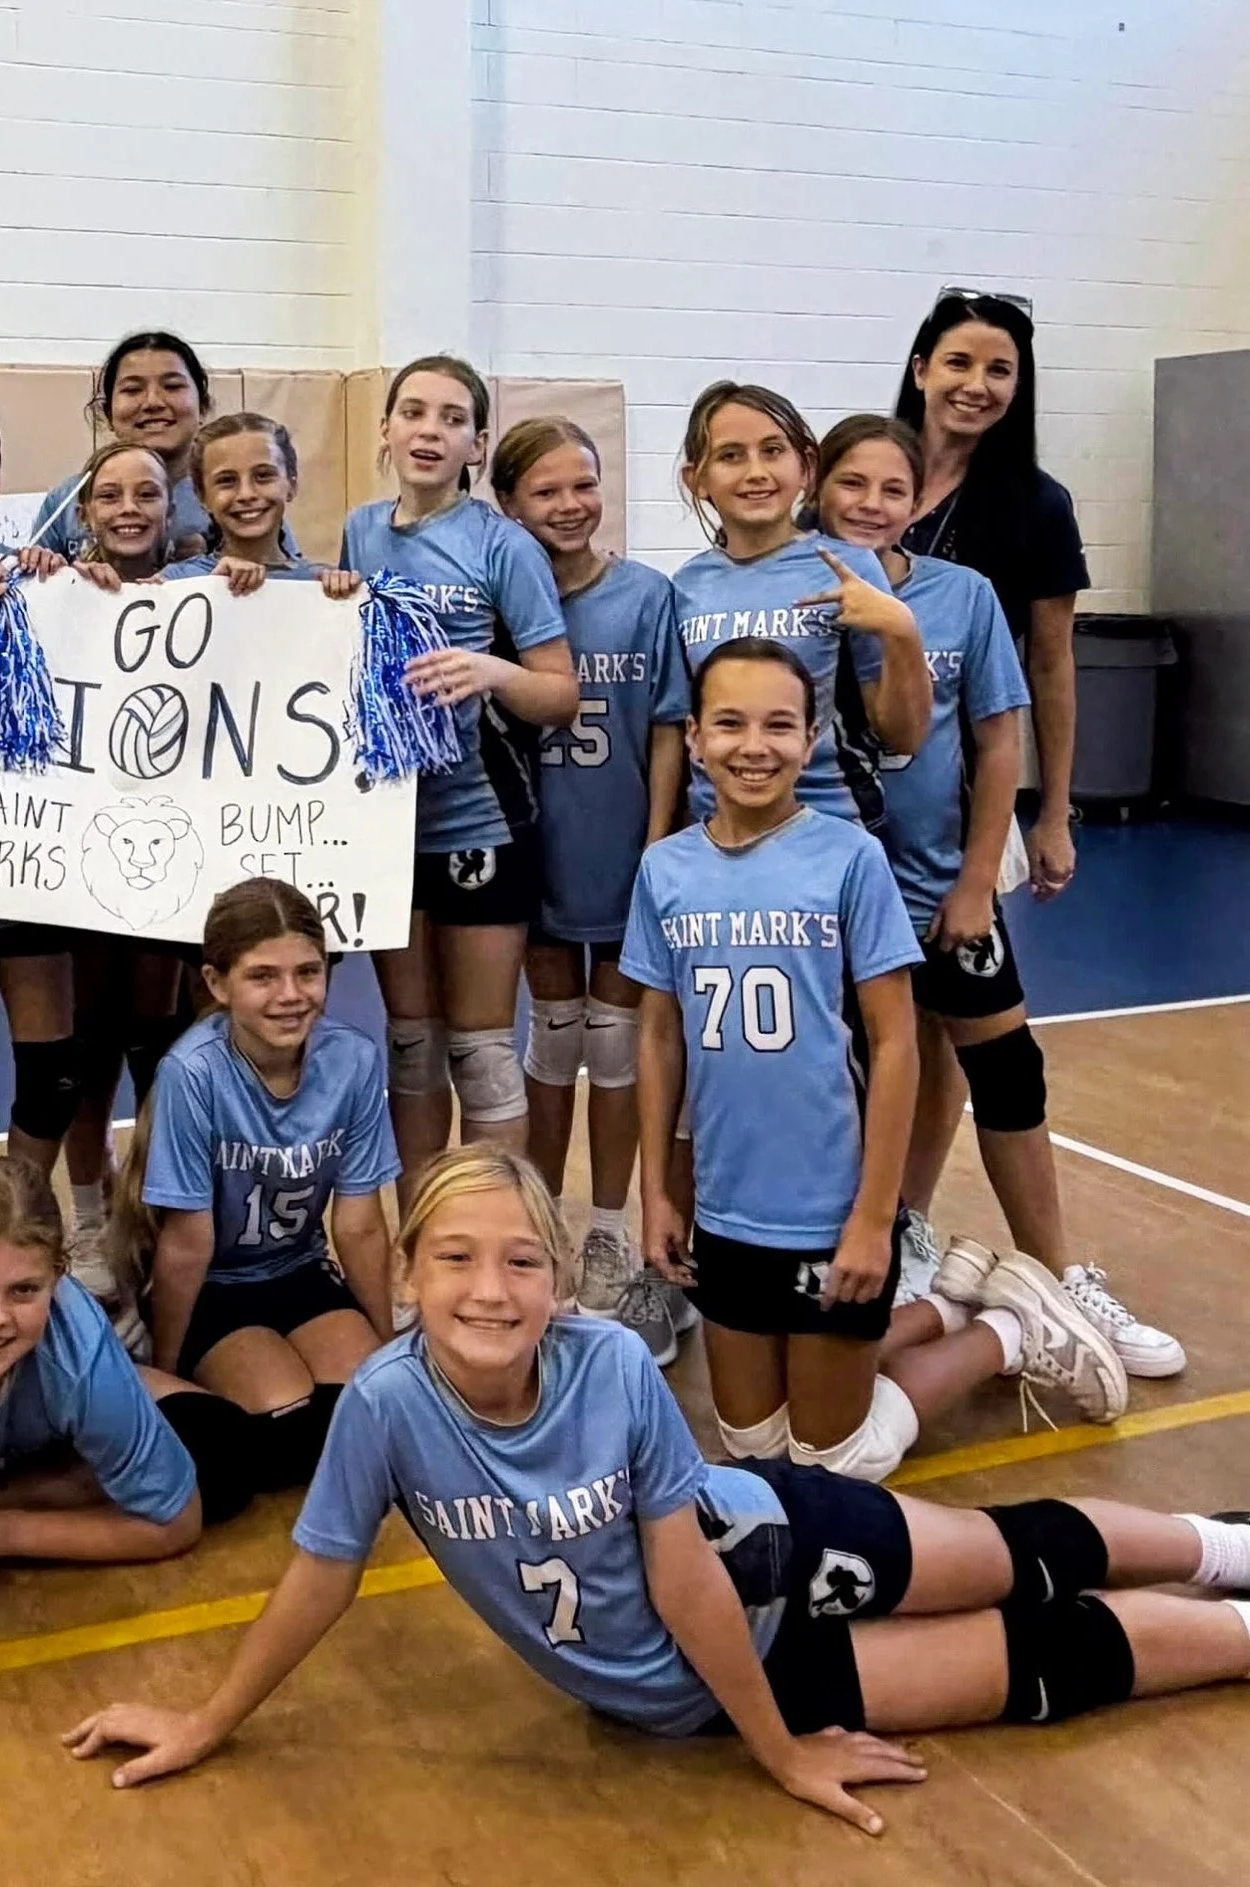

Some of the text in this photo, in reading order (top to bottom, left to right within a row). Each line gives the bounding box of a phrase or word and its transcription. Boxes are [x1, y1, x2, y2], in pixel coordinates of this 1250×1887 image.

[113, 592, 213, 673] GO
[577, 652, 646, 683] ARK'S
[220, 799, 349, 847] BUMP...
[729, 910, 839, 948] MARK'S
[692, 964, 796, 1053] 70
[215, 1139, 277, 1176] AINT
[236, 1182, 316, 1246] 15
[415, 1490, 515, 1541] SAINT
[516, 1555, 586, 1648] 7
